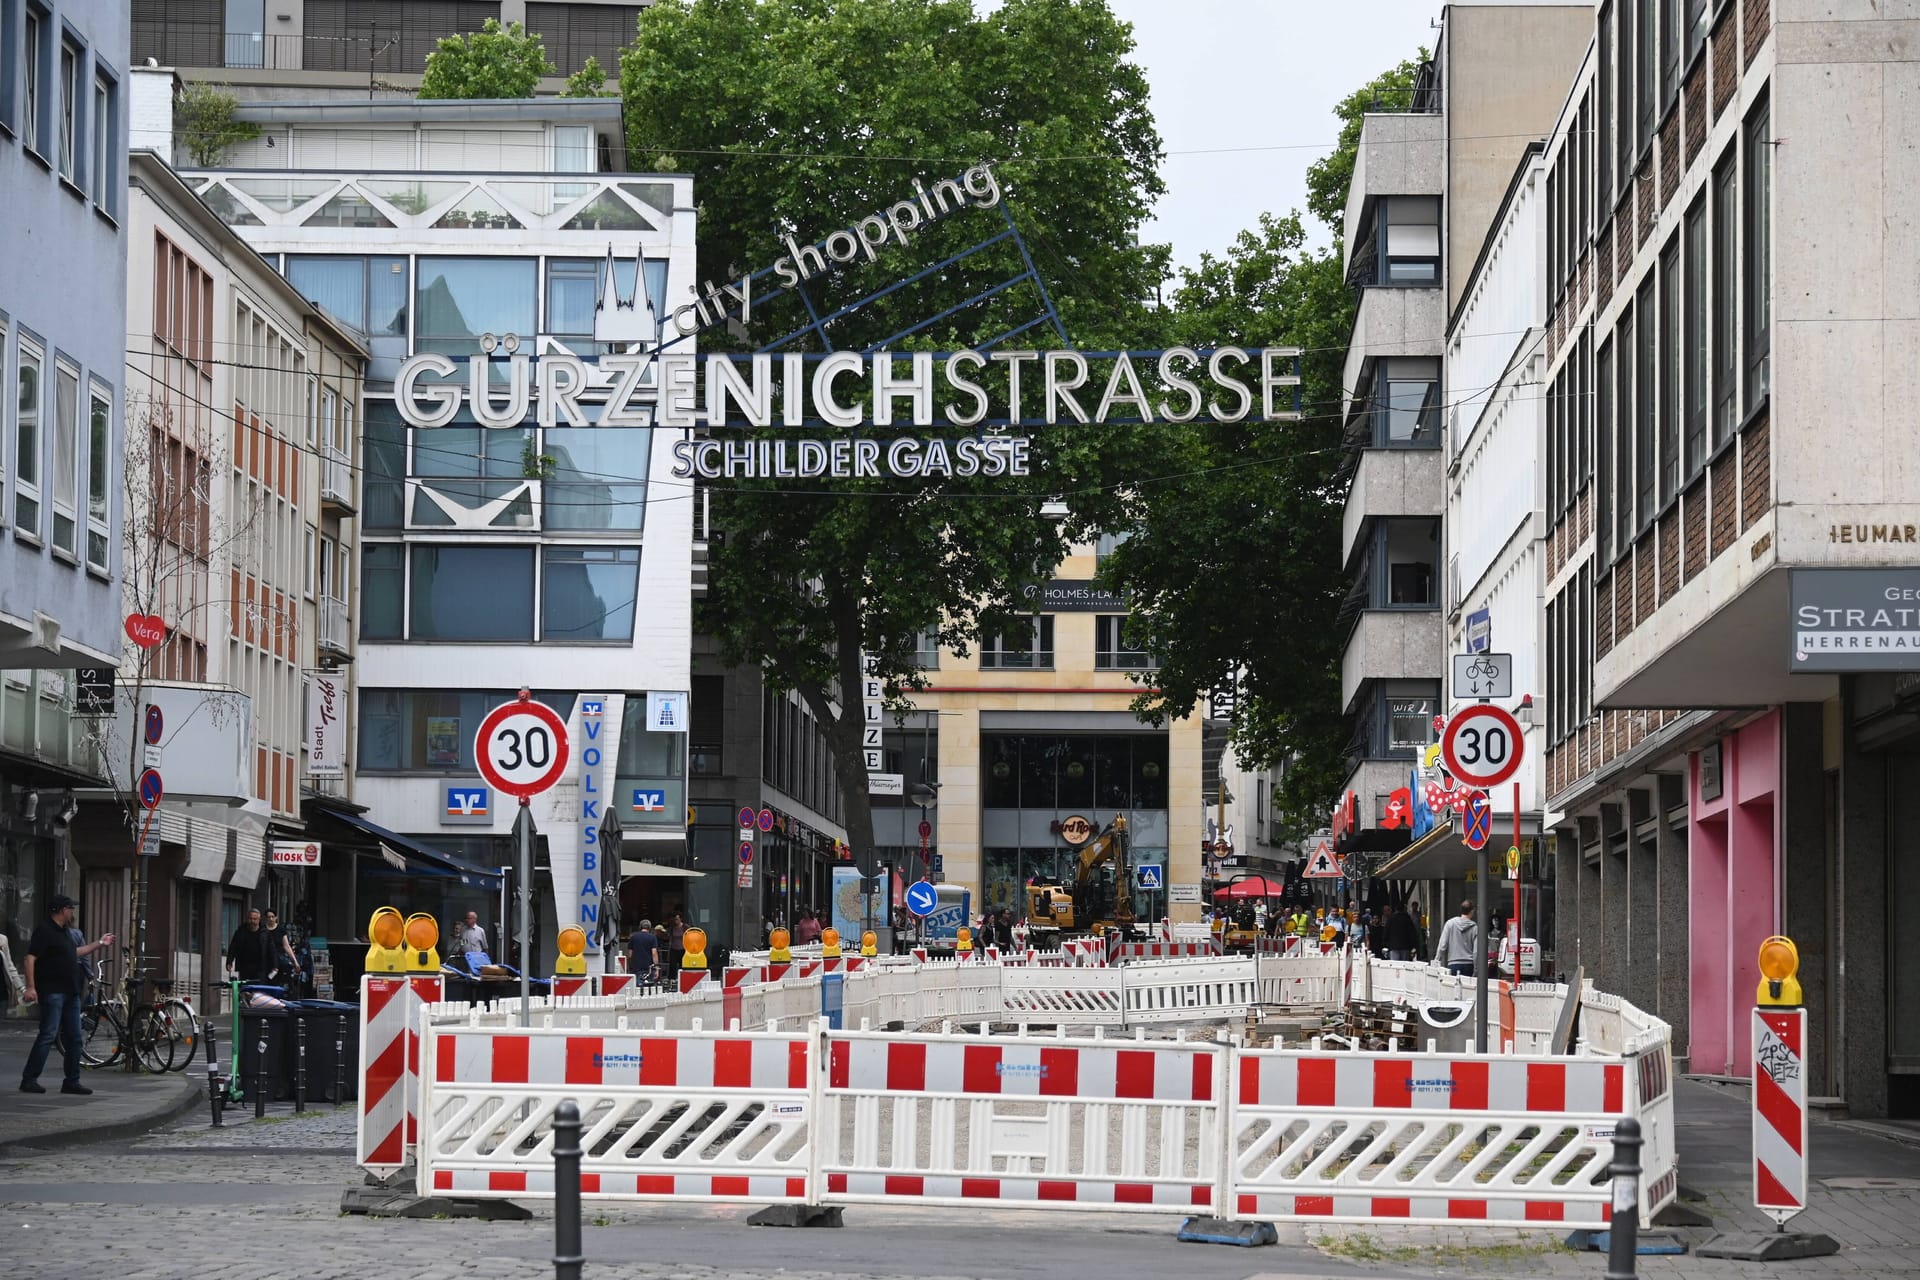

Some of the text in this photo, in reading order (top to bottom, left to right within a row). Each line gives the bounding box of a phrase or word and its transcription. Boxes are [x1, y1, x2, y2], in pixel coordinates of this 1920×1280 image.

[673, 162, 1001, 336] city shopping
[393, 332, 1303, 429] GÜRZENICHSTRASSE
[671, 437, 1030, 479] SCHILDERGASSE
[1830, 524, 1920, 543] HEUMAR
[1045, 590, 1089, 599] HOLMES
[133, 622, 160, 641] Vera
[1797, 605, 1920, 627] STRAT
[314, 678, 337, 761] Stadt Treff
[865, 656, 880, 768] PELZE
[1393, 704, 1415, 713] WIR
[497, 726, 550, 771] 30
[1459, 727, 1507, 765] 30
[581, 721, 603, 950] VOLKSBANK
[273, 852, 304, 862] KIOSK
